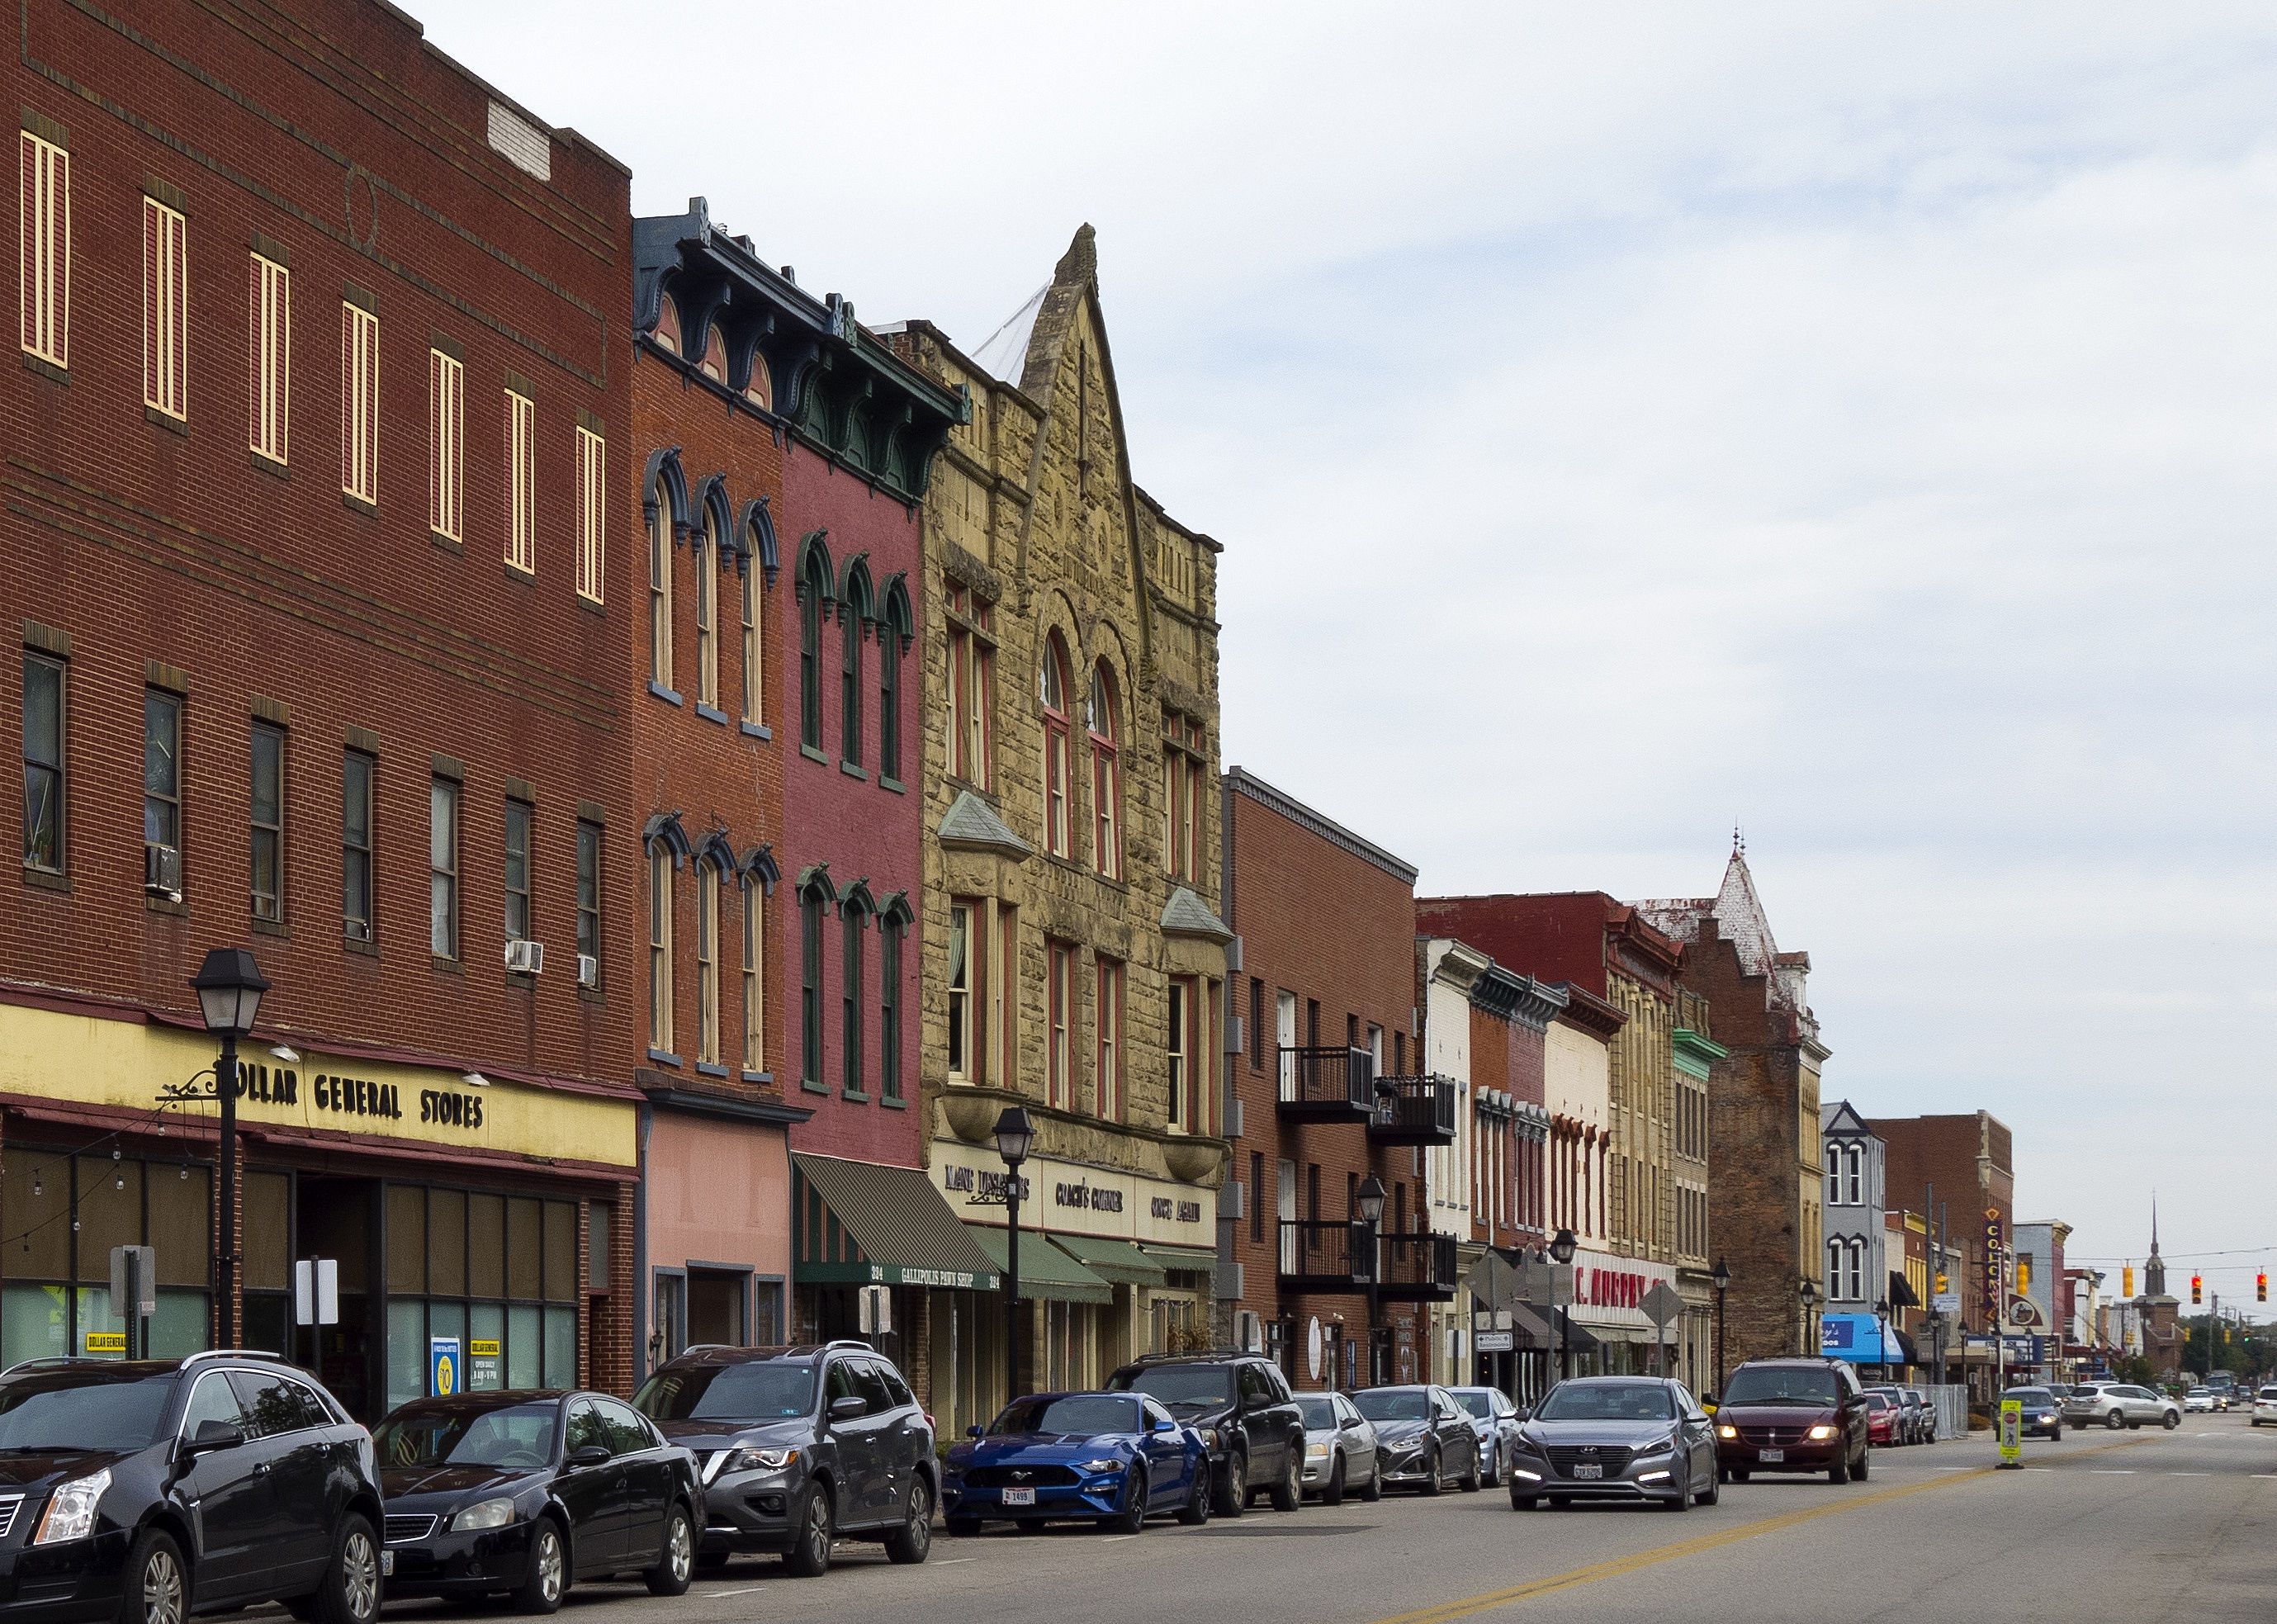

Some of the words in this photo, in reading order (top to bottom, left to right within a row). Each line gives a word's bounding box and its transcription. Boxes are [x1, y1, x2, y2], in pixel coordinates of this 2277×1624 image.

[216, 1061, 297, 1106] OLLAR
[315, 1074, 402, 1119] GENERAL
[420, 1089, 483, 1128] STORES
[871, 1266, 883, 1281] 324
[902, 1267, 940, 1285] GALLIPOLIS
[940, 1271, 957, 1286] PAWN
[957, 1272, 973, 1288] SHOP
[1591, 1268, 1646, 1309] MURPHY
[88, 1336, 106, 1347] DOLLAR
